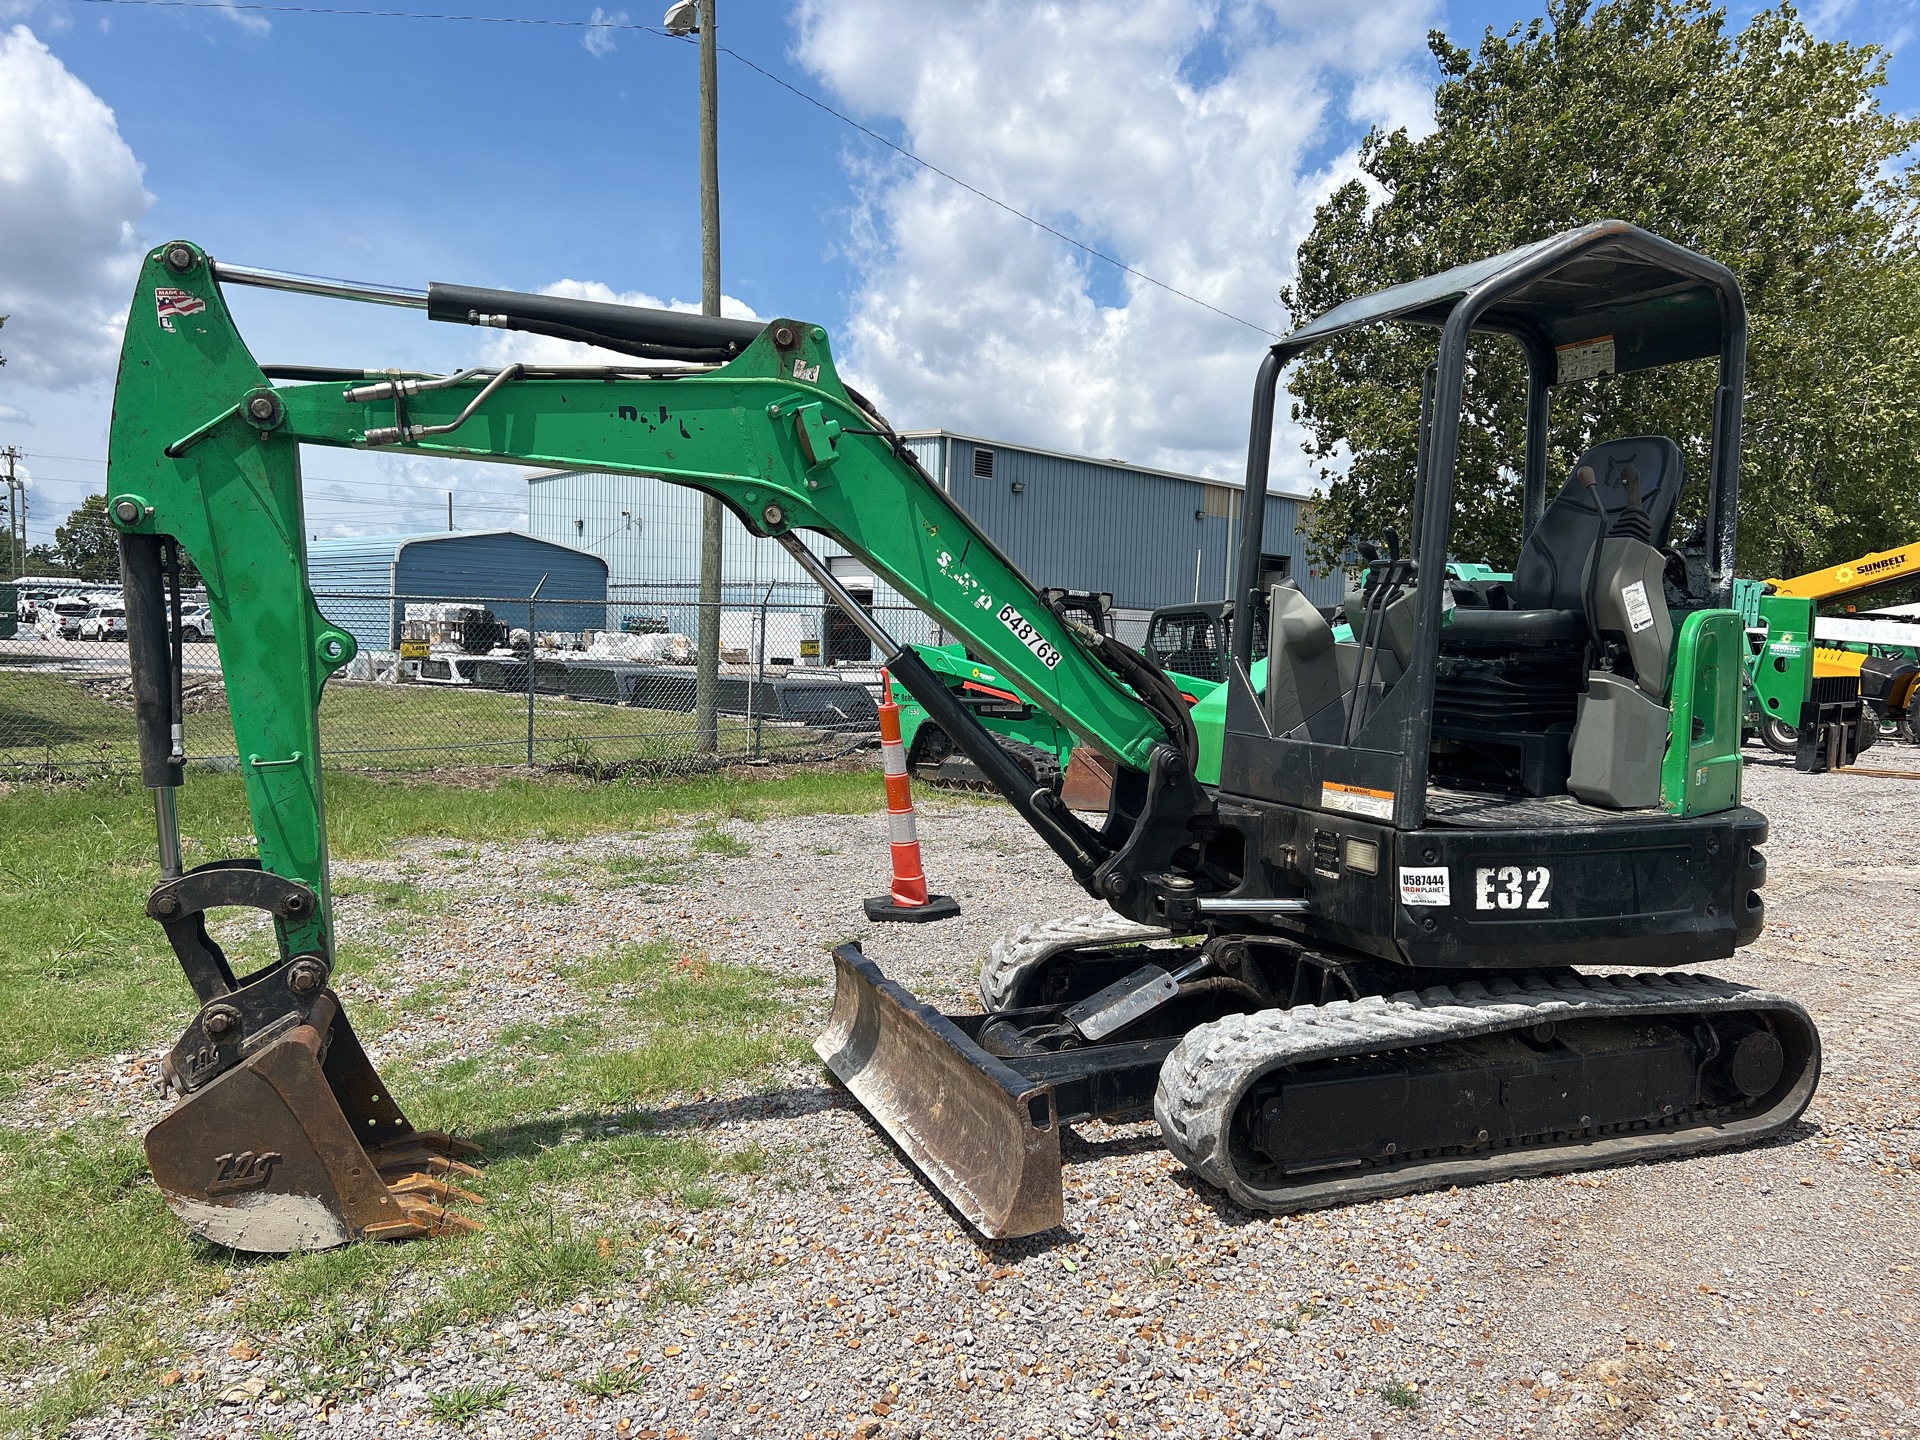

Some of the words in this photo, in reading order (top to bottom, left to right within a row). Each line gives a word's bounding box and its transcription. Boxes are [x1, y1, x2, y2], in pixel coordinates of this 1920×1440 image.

[1856, 554, 1906, 574] SUNBELT
[1864, 564, 1900, 576] RENTALS
[1000, 606, 1060, 667] 648768
[1350, 787, 1370, 795] WARNING
[1403, 874, 1444, 886] U587444
[1476, 866, 1550, 910] E32
